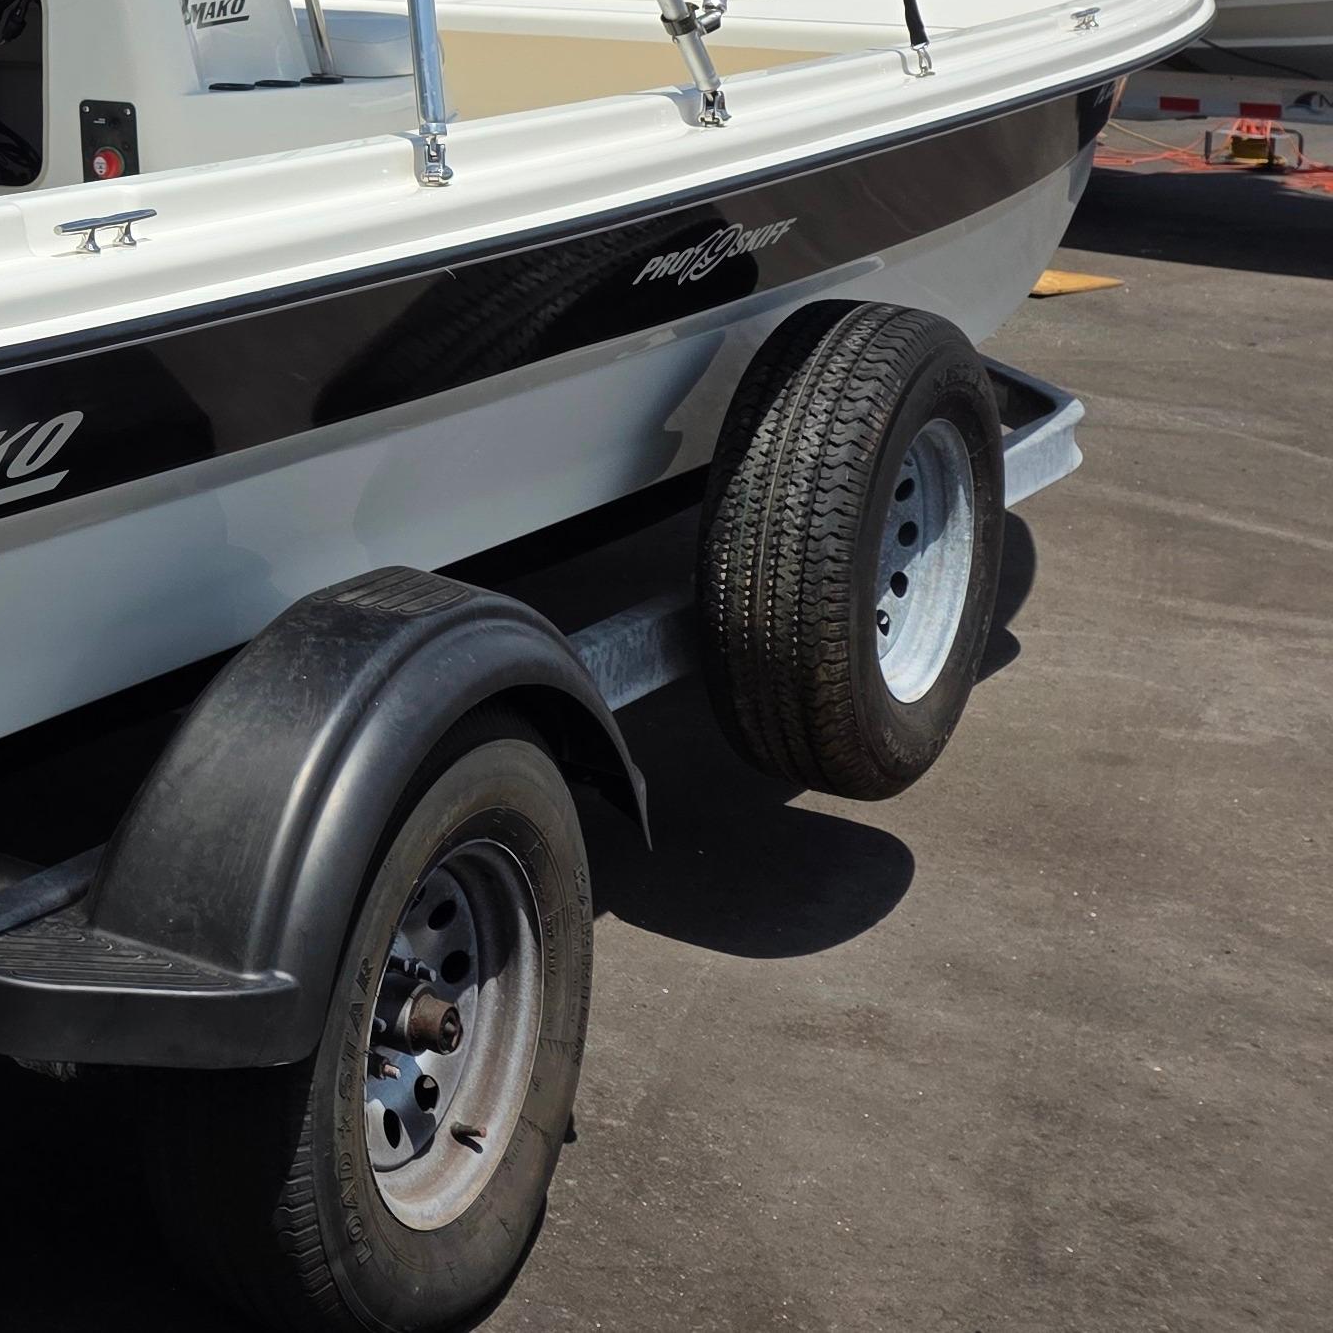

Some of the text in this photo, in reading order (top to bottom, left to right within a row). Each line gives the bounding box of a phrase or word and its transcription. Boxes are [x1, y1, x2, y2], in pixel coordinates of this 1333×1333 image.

[632, 248, 694, 286] PRO
[727, 217, 798, 258] SKIFF
[338, 956, 375, 1266] LOAD STAR
